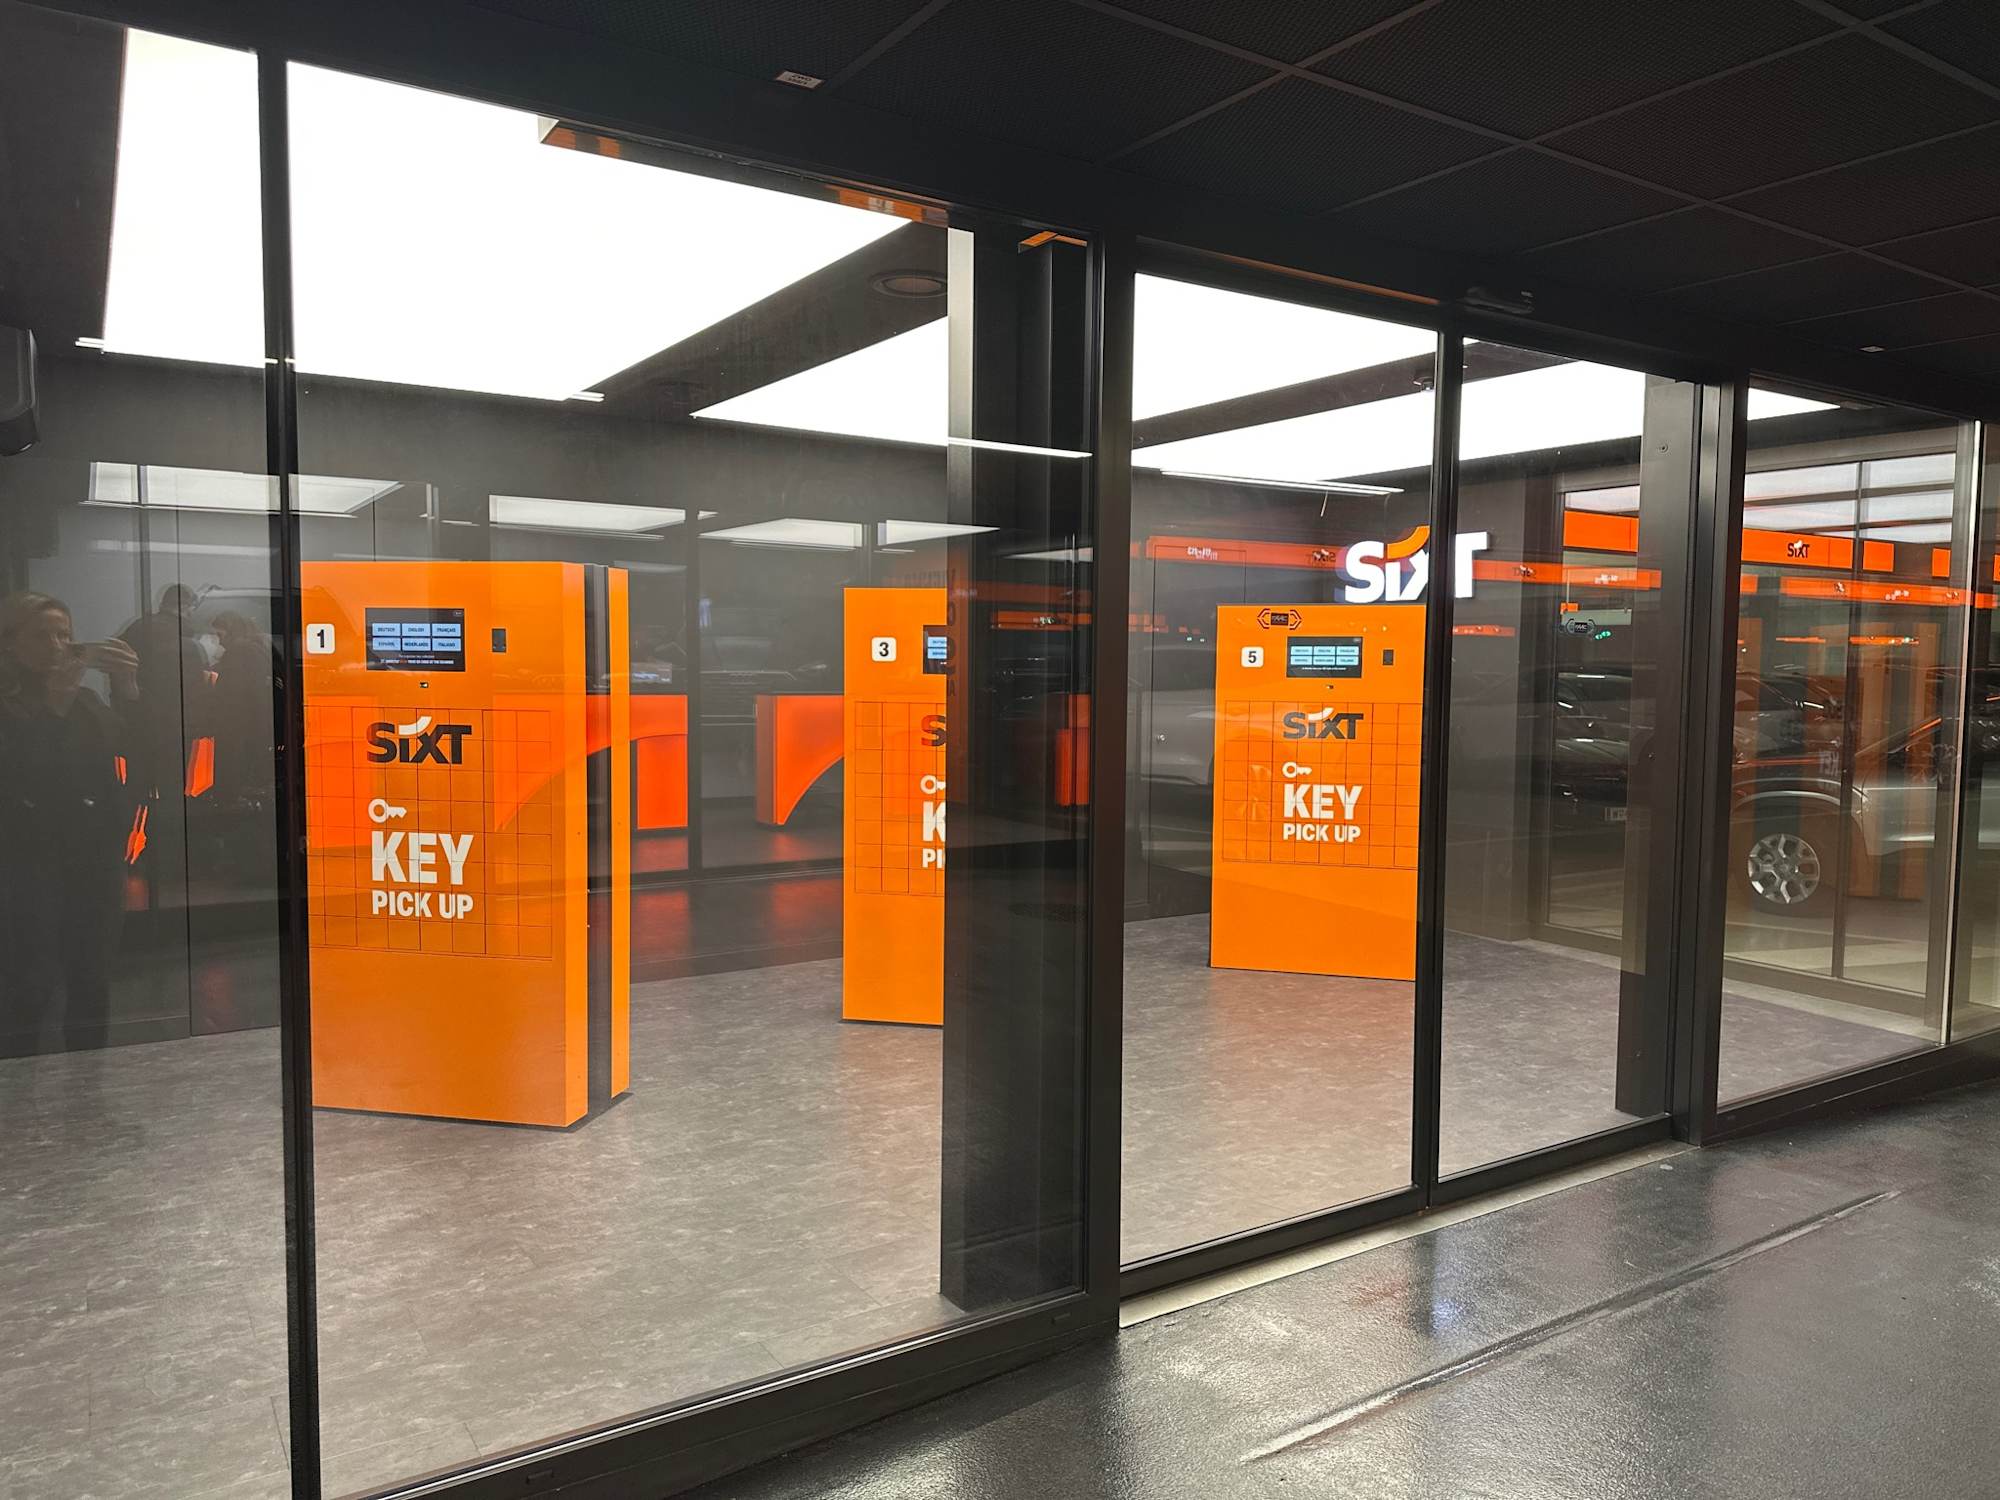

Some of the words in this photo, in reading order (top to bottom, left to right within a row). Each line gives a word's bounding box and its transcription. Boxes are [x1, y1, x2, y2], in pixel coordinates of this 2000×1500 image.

[316, 629, 325, 649] 1
[879, 642, 890, 657] 3
[1248, 651, 1257, 664] 5
[1283, 783, 1363, 821] KEY
[1283, 823, 1329, 842] PICK
[1334, 825, 1361, 843] UP
[371, 830, 475, 886] KEY
[371, 889, 433, 918] PICK
[438, 892, 474, 920] UP
